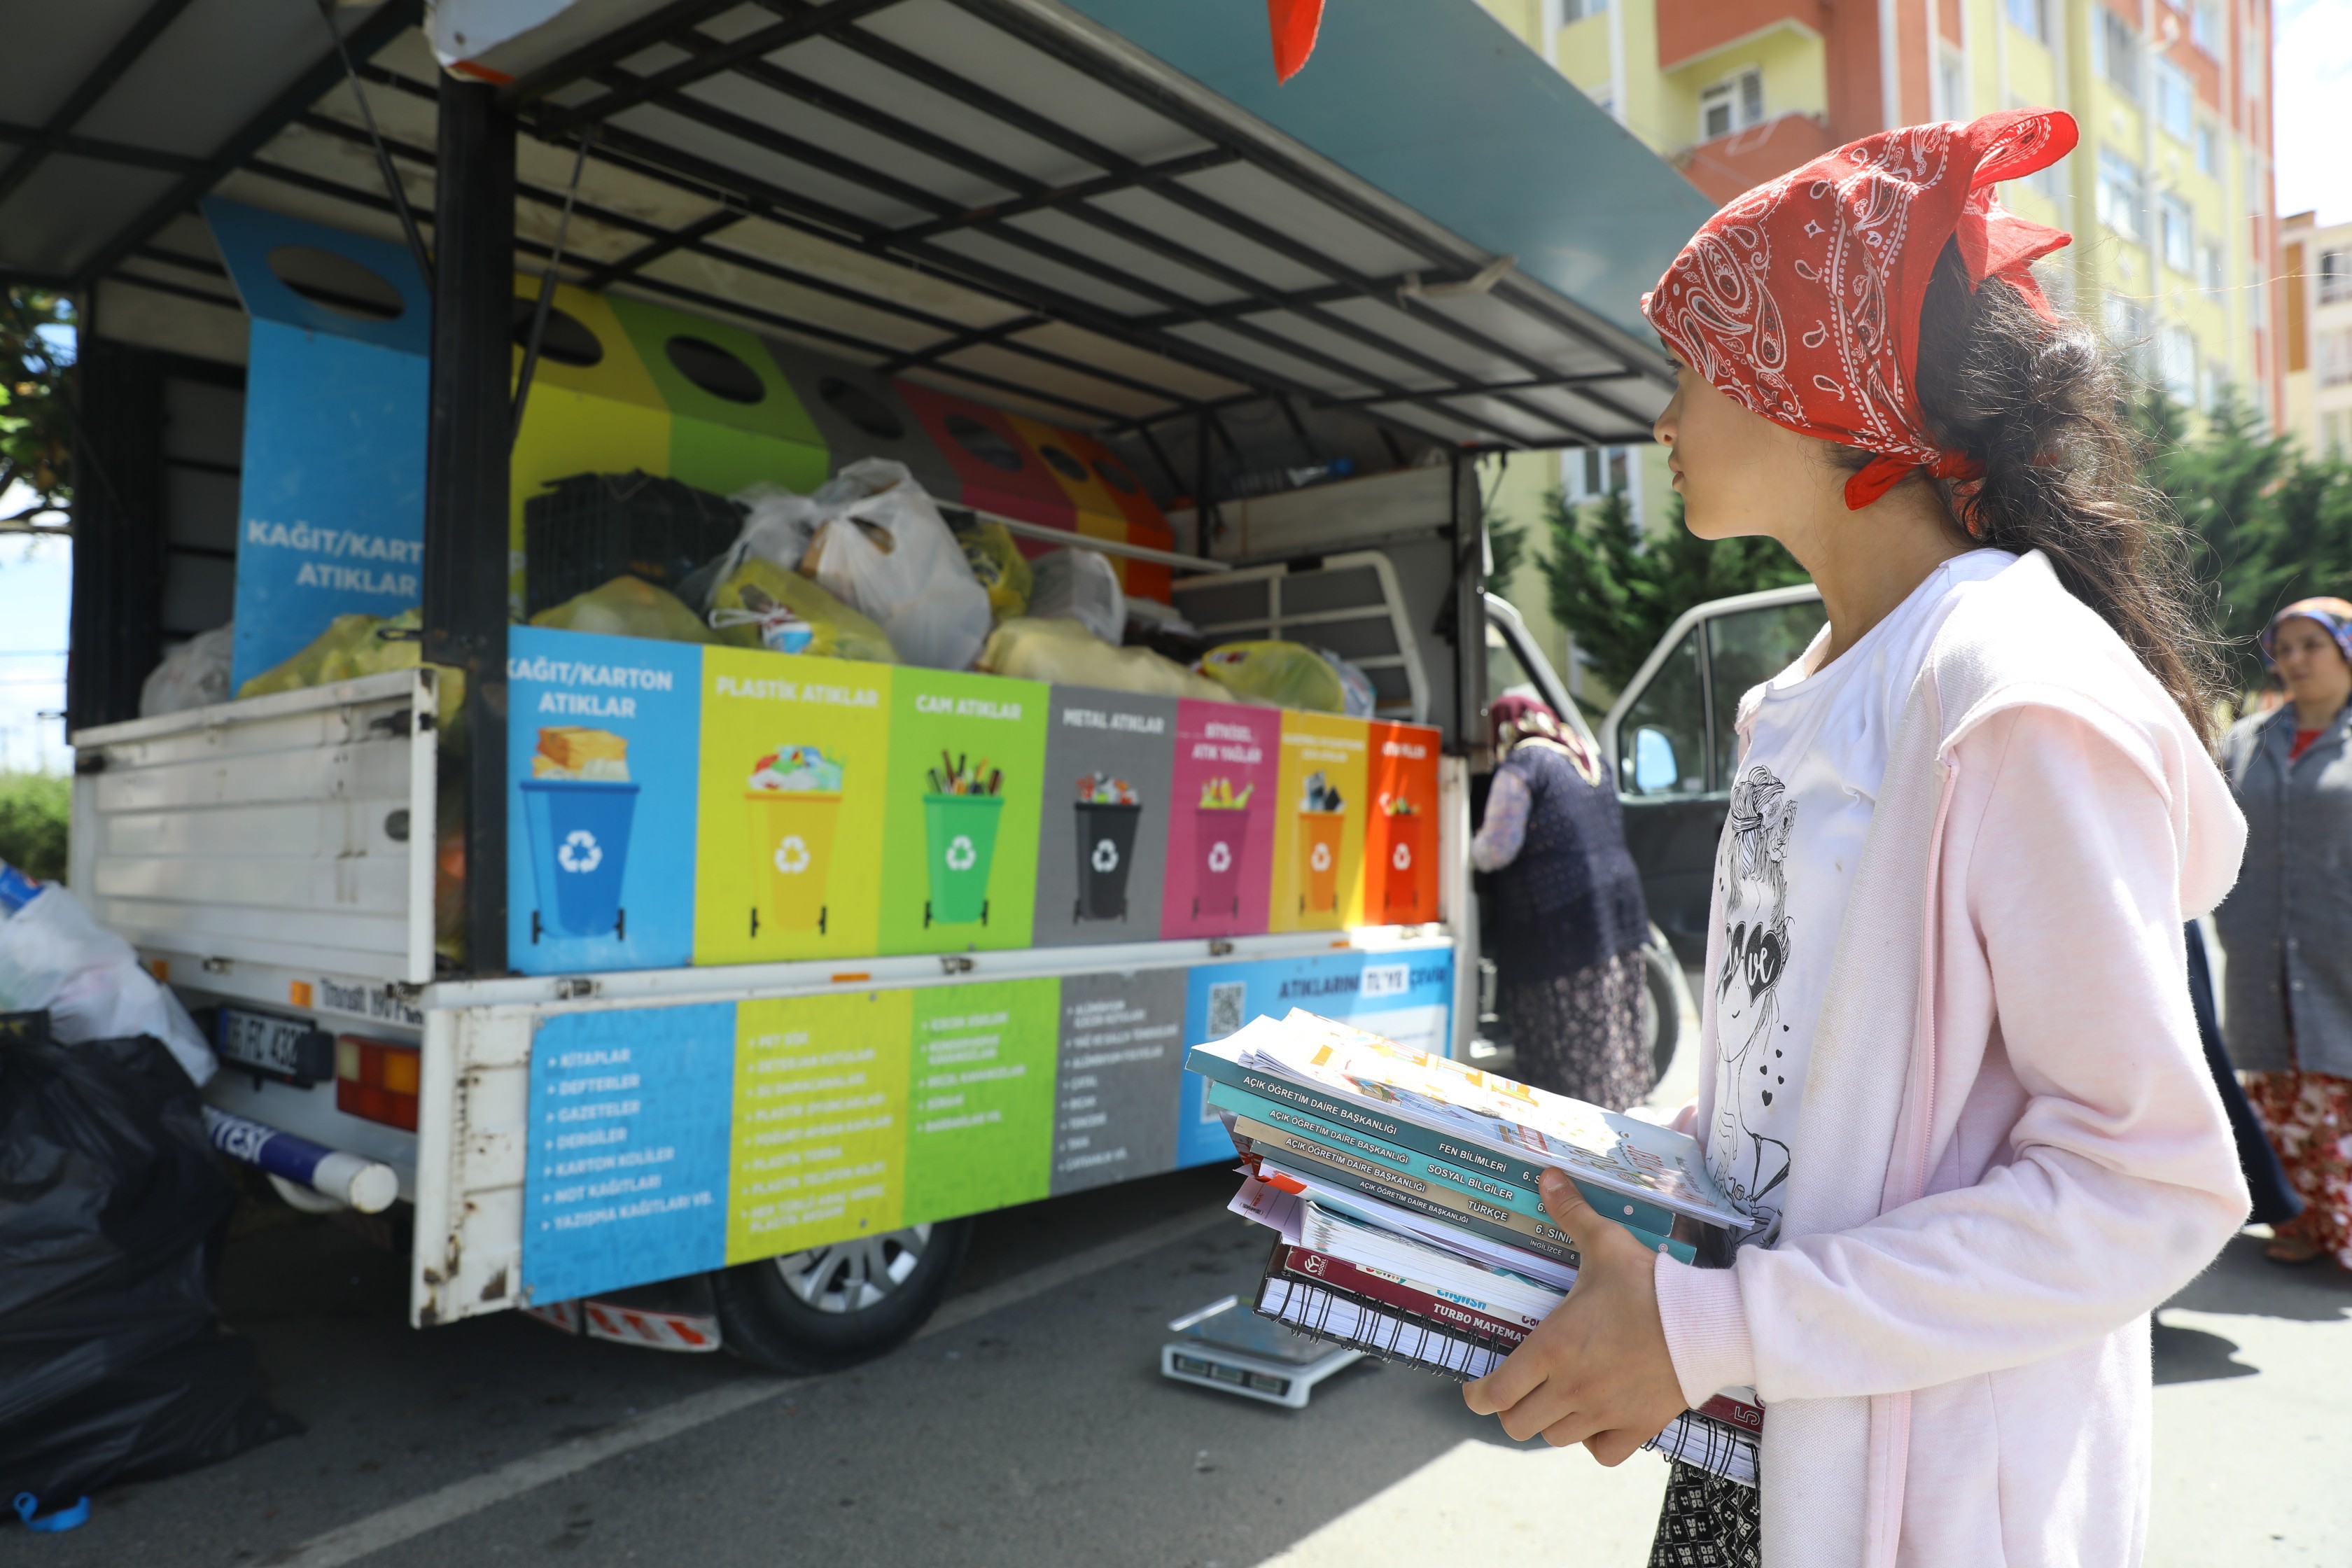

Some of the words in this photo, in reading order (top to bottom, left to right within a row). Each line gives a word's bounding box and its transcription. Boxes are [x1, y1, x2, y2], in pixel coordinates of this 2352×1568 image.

[296, 563, 417, 596] ATIKLAR
[538, 692, 636, 718] ATIKLAR
[716, 676, 797, 701] PLASTİK
[801, 684, 879, 708] ATIKLAR
[916, 695, 953, 713] CAM
[956, 699, 1021, 720] ATIKLAR
[1063, 708, 1107, 730] METAL
[1110, 713, 1165, 734] ATIKLAR
[1243, 1076, 1266, 1089] AÇIK
[1268, 1083, 1309, 1105] ÖĞRETİM
[1310, 1098, 1338, 1115] DAİRE
[1340, 1109, 1397, 1135] BAŞKANLIĞI
[1270, 1110, 1290, 1122] AÇIK
[1292, 1116, 1329, 1136] ÖĞRETİM
[1330, 1130, 1355, 1145] DAİRE
[1357, 1141, 1408, 1163] BAŞKANLIĞI
[1285, 1138, 1306, 1151] AÇIK
[1308, 1144, 1345, 1164] ÖĞRETİM
[1346, 1158, 1373, 1174] DAİRE
[1374, 1168, 1425, 1192] BAŞKANLIĞI
[1438, 1143, 1458, 1156] FEN
[1460, 1150, 1507, 1173] BİLİMLERİ
[1522, 1171, 1531, 1182] 6.
[1427, 1163, 1465, 1184] SOSYAL
[1468, 1177, 1513, 1200] BİLGİLER
[1359, 1181, 1376, 1191] AÇIK
[1377, 1186, 1406, 1202] ÖĞRETİM
[1408, 1198, 1427, 1210] DAİRE
[1429, 1205, 1469, 1224] BAŞKANLIĞI
[1468, 1200, 1508, 1222] TÜRKÇE
[1535, 1224, 1544, 1236] 6.
[1530, 1238, 1562, 1256] İNGİLİZCE
[1317, 1258, 1327, 1277] MODEL
[1434, 1303, 1472, 1324] TURBO
